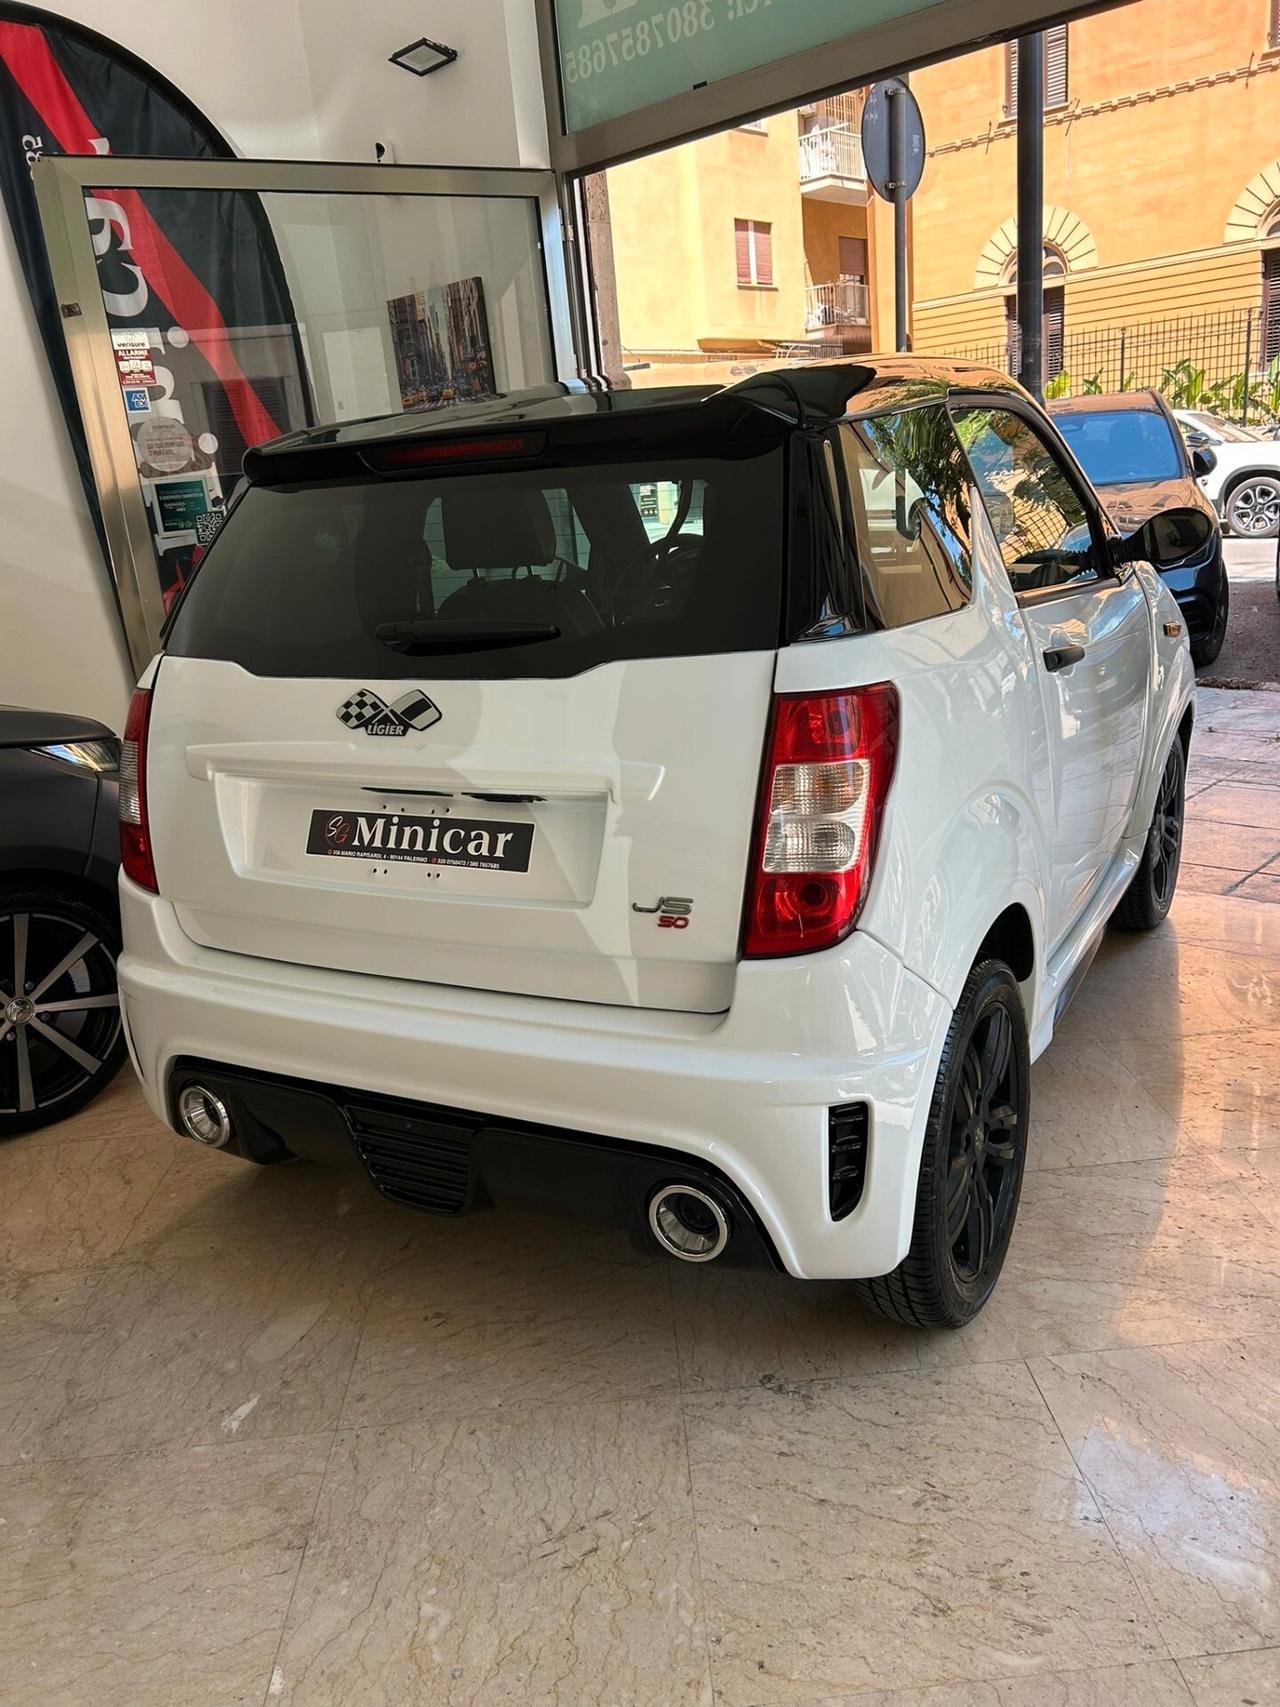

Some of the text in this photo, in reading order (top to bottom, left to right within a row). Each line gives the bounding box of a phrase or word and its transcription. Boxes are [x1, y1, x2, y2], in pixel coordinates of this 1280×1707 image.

[132, 393, 148, 401] AM
[351, 815, 514, 858] Minicar
[403, 855, 428, 863] PALERMO
[632, 896, 694, 915] JS
[657, 915, 690, 929] 50
